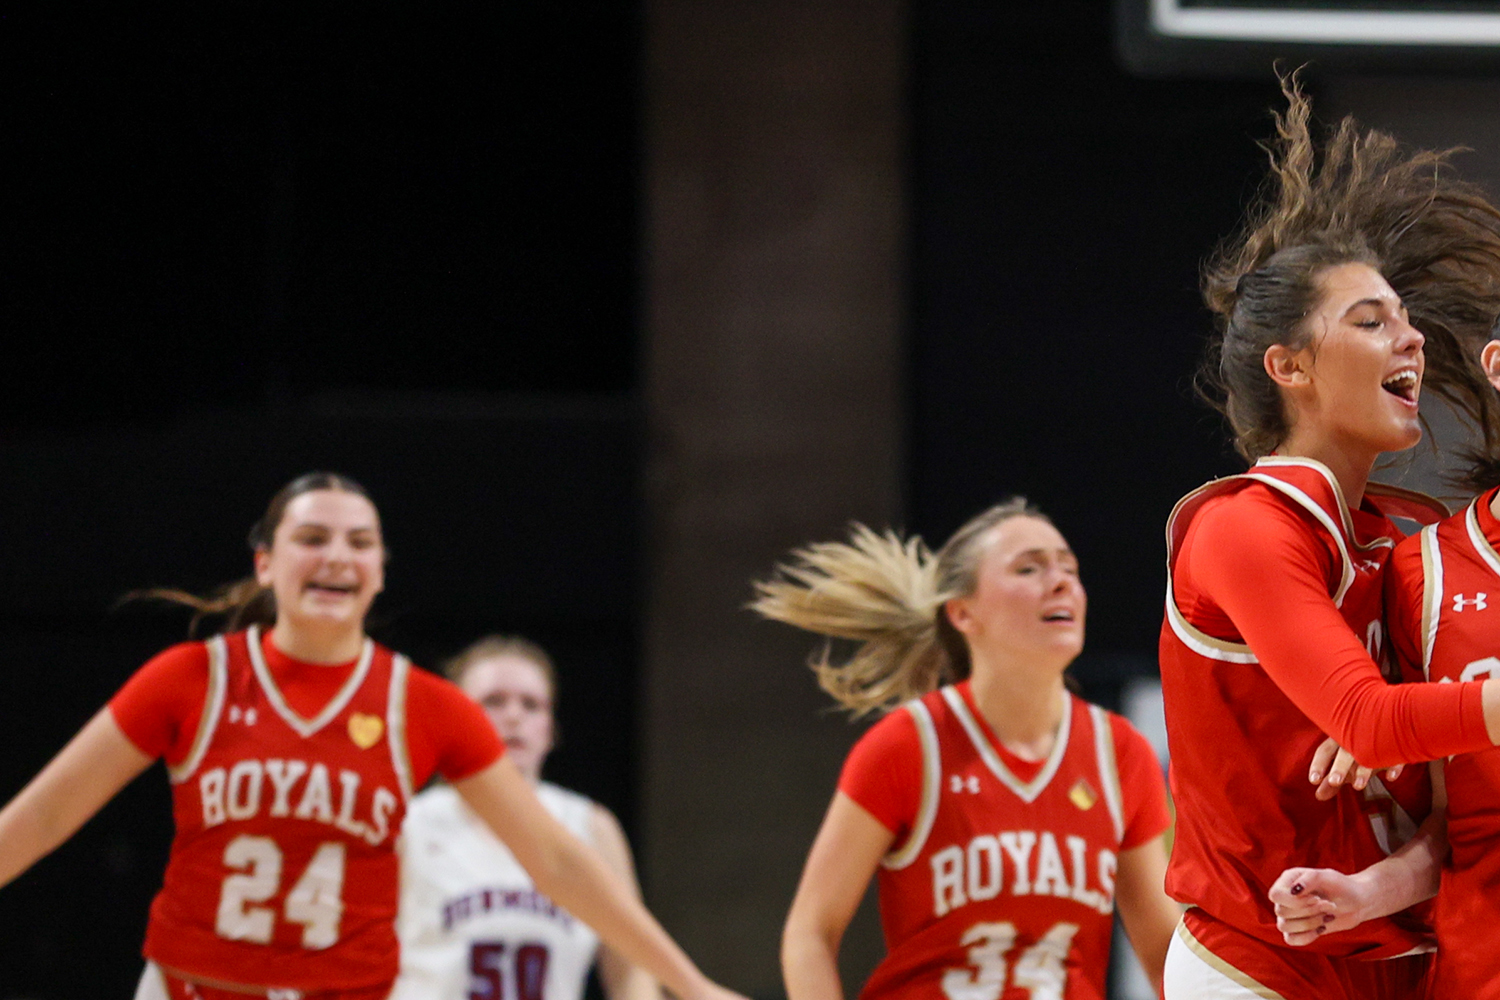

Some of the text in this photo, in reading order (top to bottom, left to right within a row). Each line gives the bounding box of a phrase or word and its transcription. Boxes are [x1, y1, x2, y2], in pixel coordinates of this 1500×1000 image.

[200, 759, 397, 847] ROYALS
[215, 835, 345, 949] 24
[930, 831, 1118, 916] ROYALS
